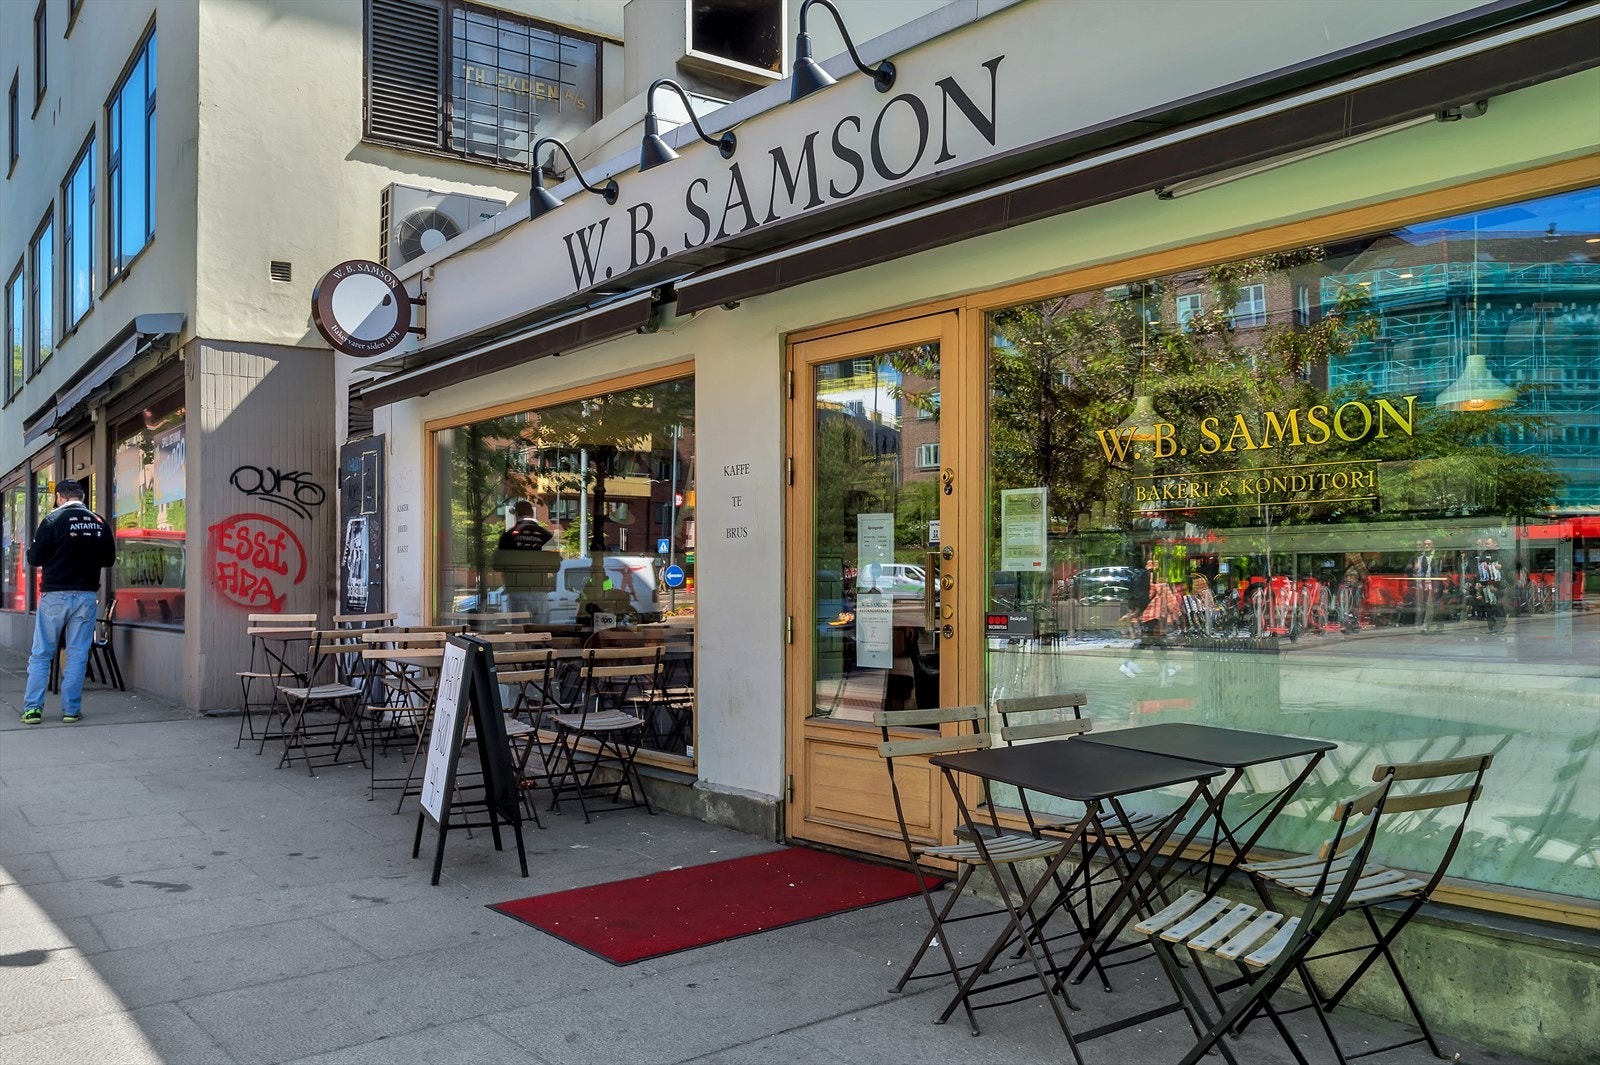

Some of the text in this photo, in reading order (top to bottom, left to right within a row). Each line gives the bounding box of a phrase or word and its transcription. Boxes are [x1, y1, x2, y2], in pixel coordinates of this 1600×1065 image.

[562, 55, 1005, 291] W. B. SAMSON
[332, 263, 399, 289] W. B. SAMSON
[366, 342, 385, 350] siden
[1094, 395, 1418, 464] W. B. SAMSON
[723, 463, 750, 477] KAFFE
[1135, 469, 1375, 502] BAKERI & KONDITORI
[731, 495, 743, 507] TE
[726, 526, 748, 539] BRUS
